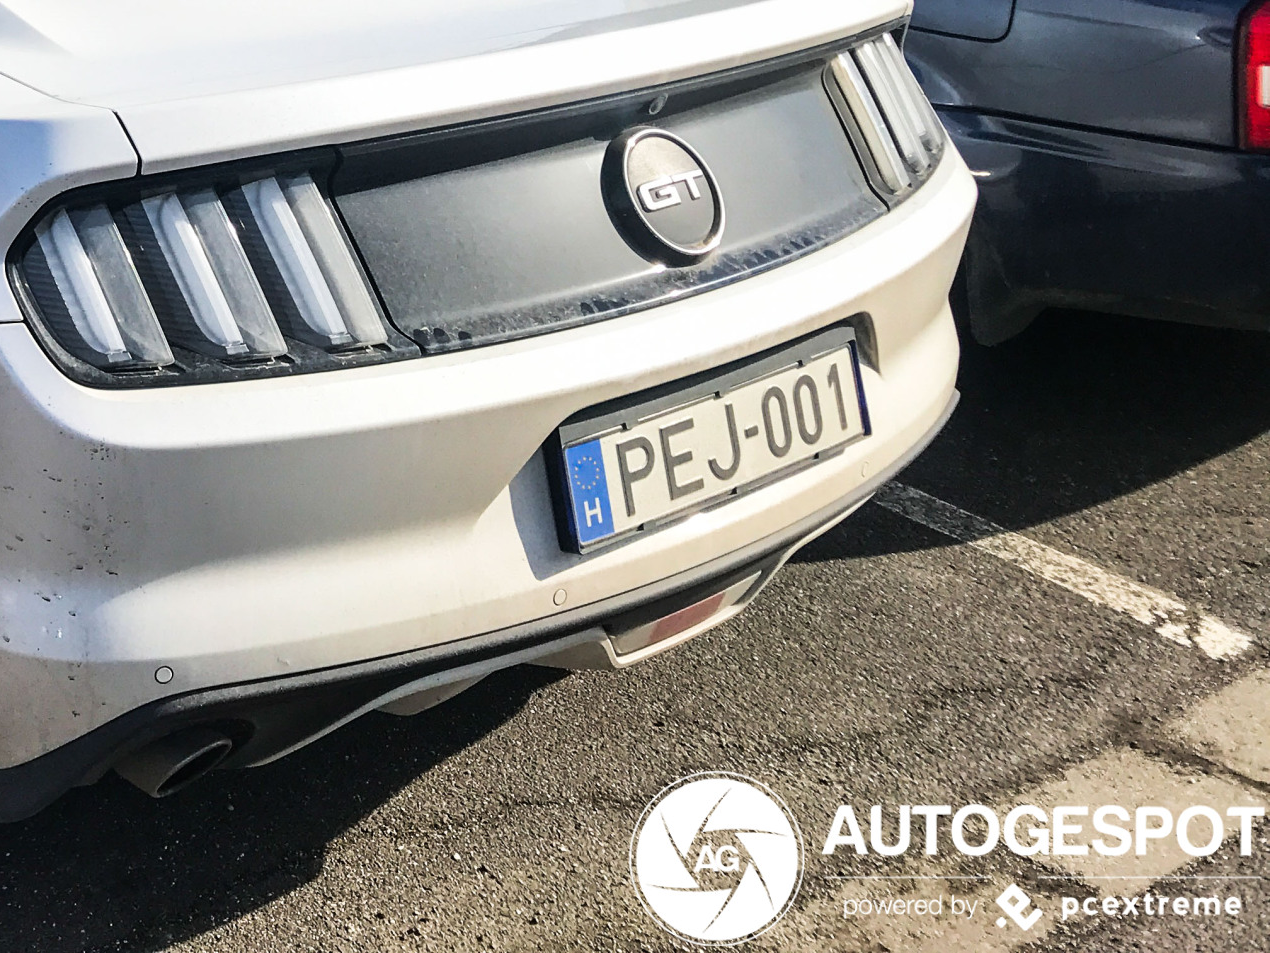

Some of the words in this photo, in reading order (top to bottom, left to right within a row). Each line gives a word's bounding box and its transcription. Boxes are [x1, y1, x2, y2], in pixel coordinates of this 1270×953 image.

[636, 169, 703, 213] GT
[616, 363, 848, 517] PEJ-001
[583, 497, 603, 527] H
